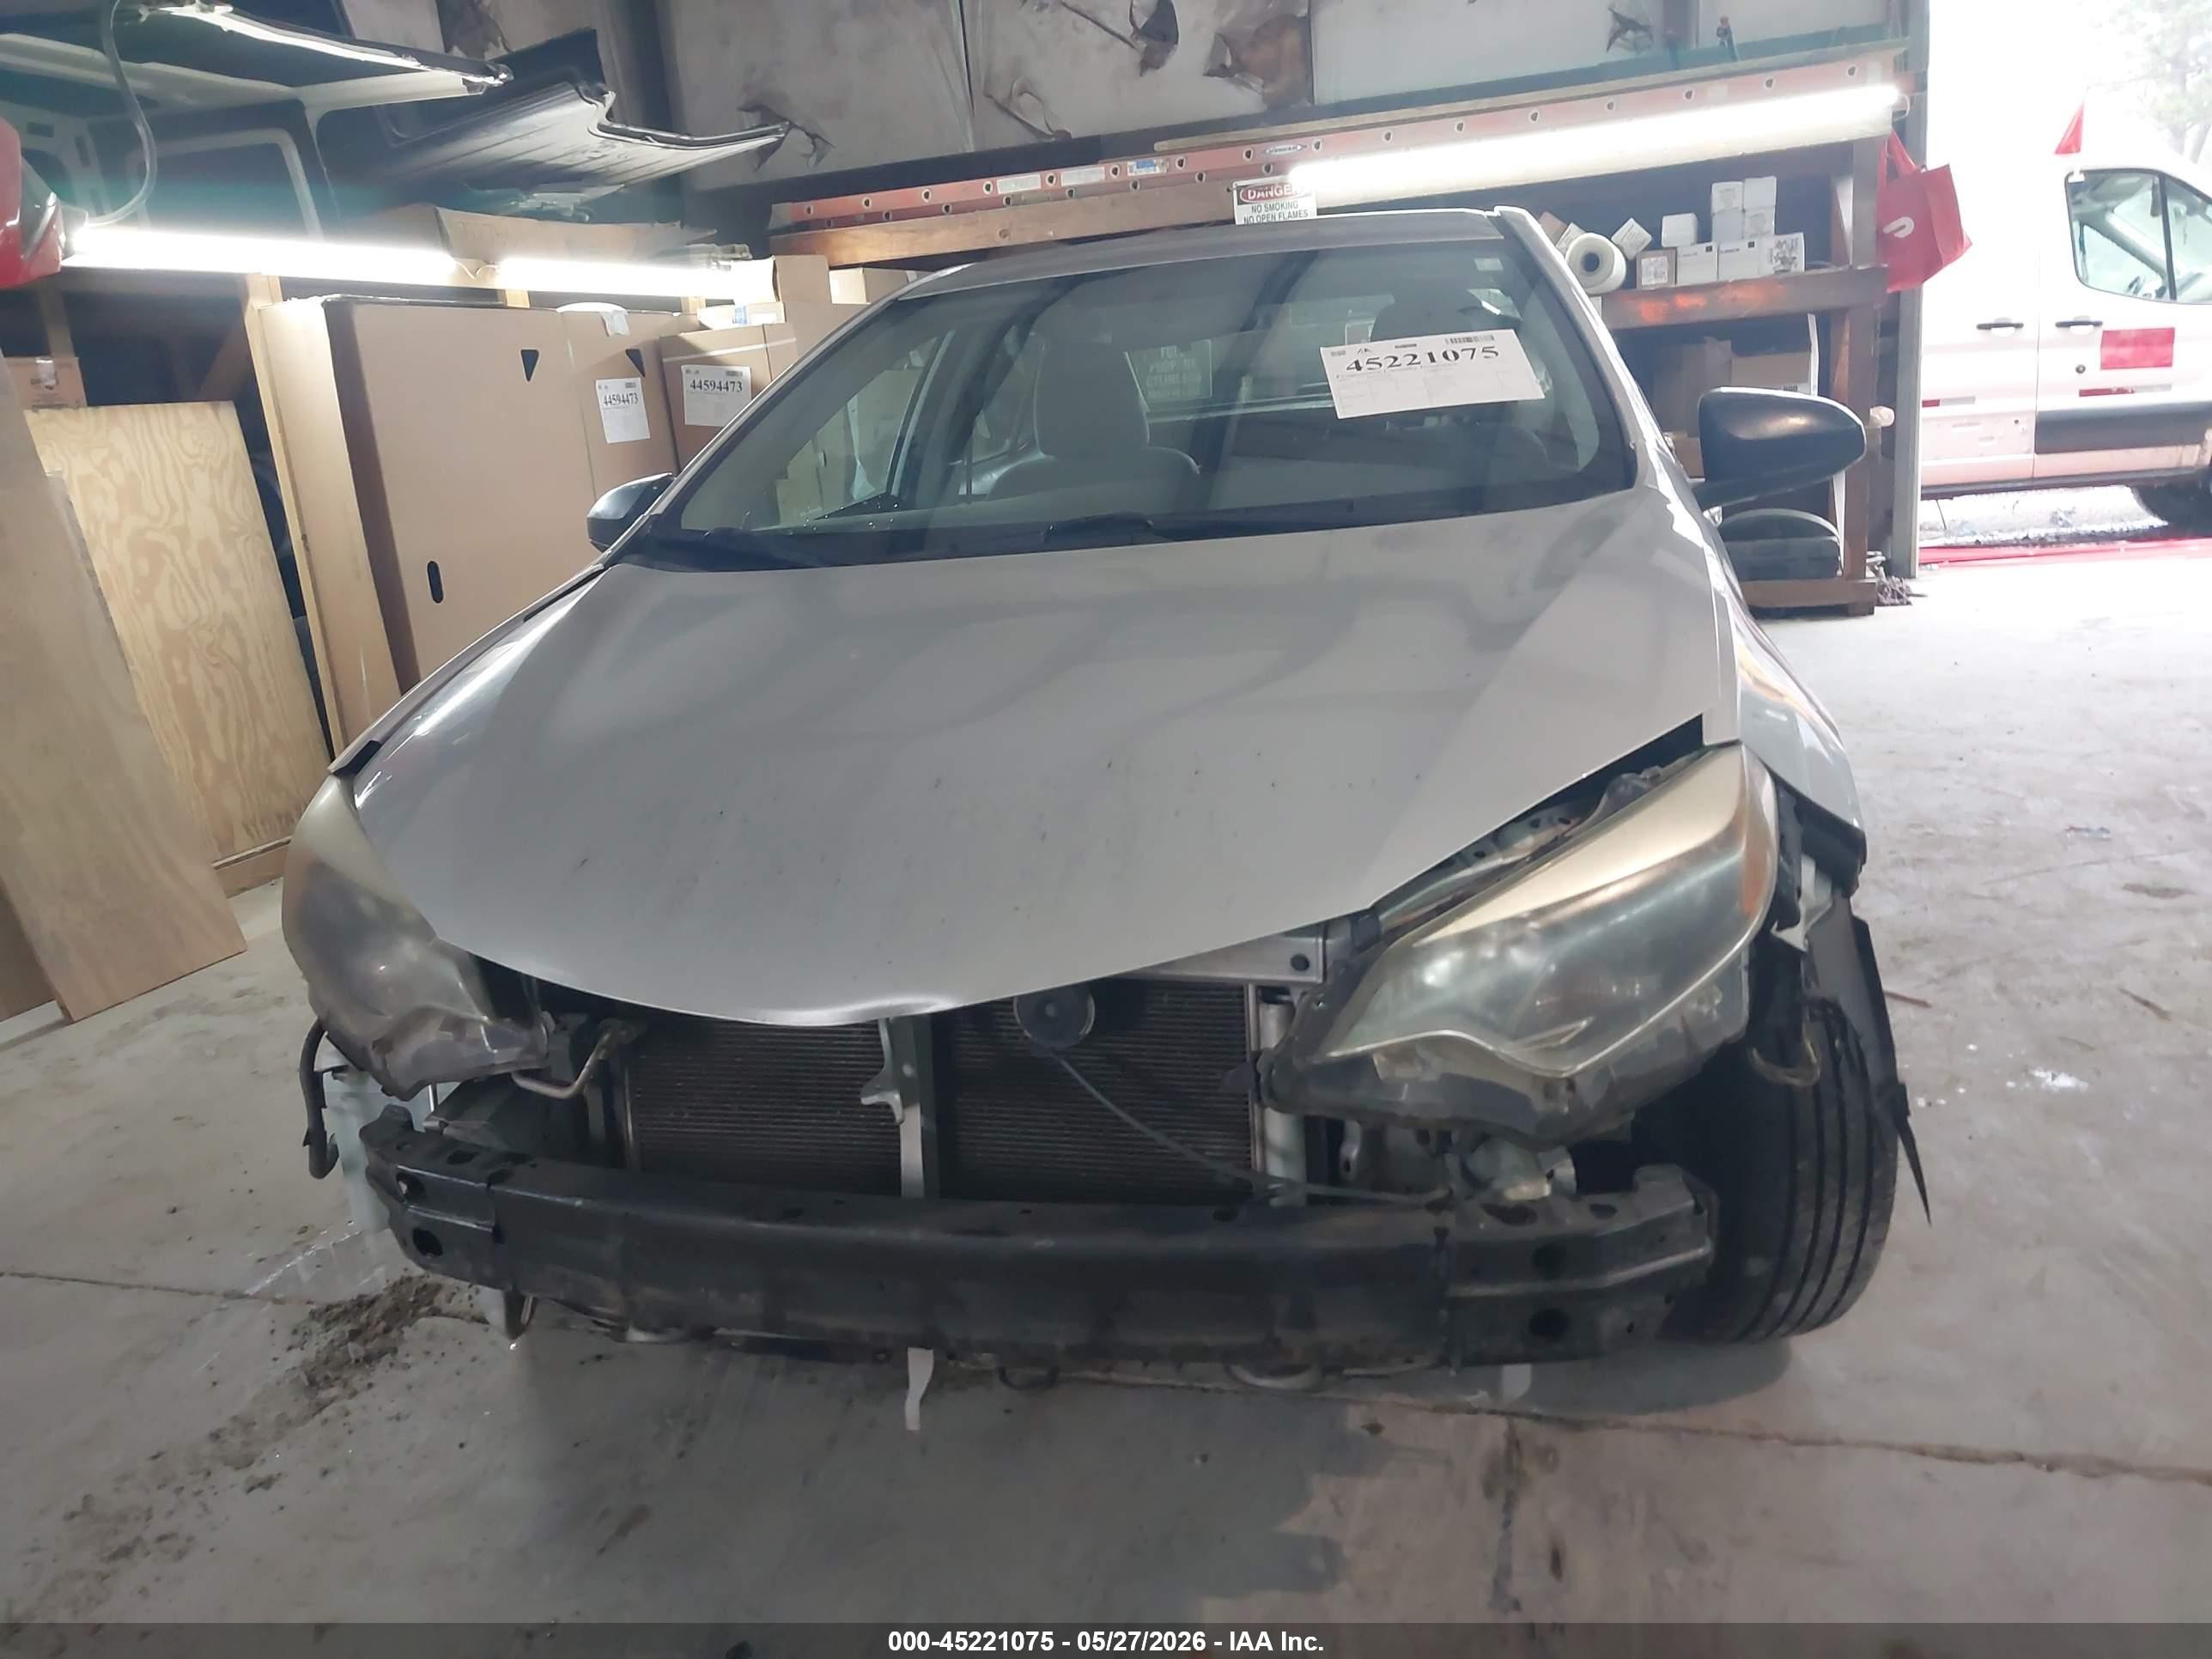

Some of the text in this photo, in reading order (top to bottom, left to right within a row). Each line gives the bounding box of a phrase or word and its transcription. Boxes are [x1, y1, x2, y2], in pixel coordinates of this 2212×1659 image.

[1248, 183, 1297, 200] DANGE
[1251, 200, 1298, 214] NO SMOKING
[1243, 210, 1309, 224] NO OPEN FLAMES
[1346, 345, 1499, 372] 45221075
[689, 378, 743, 392] 44594473
[603, 392, 639, 406] 44594473
